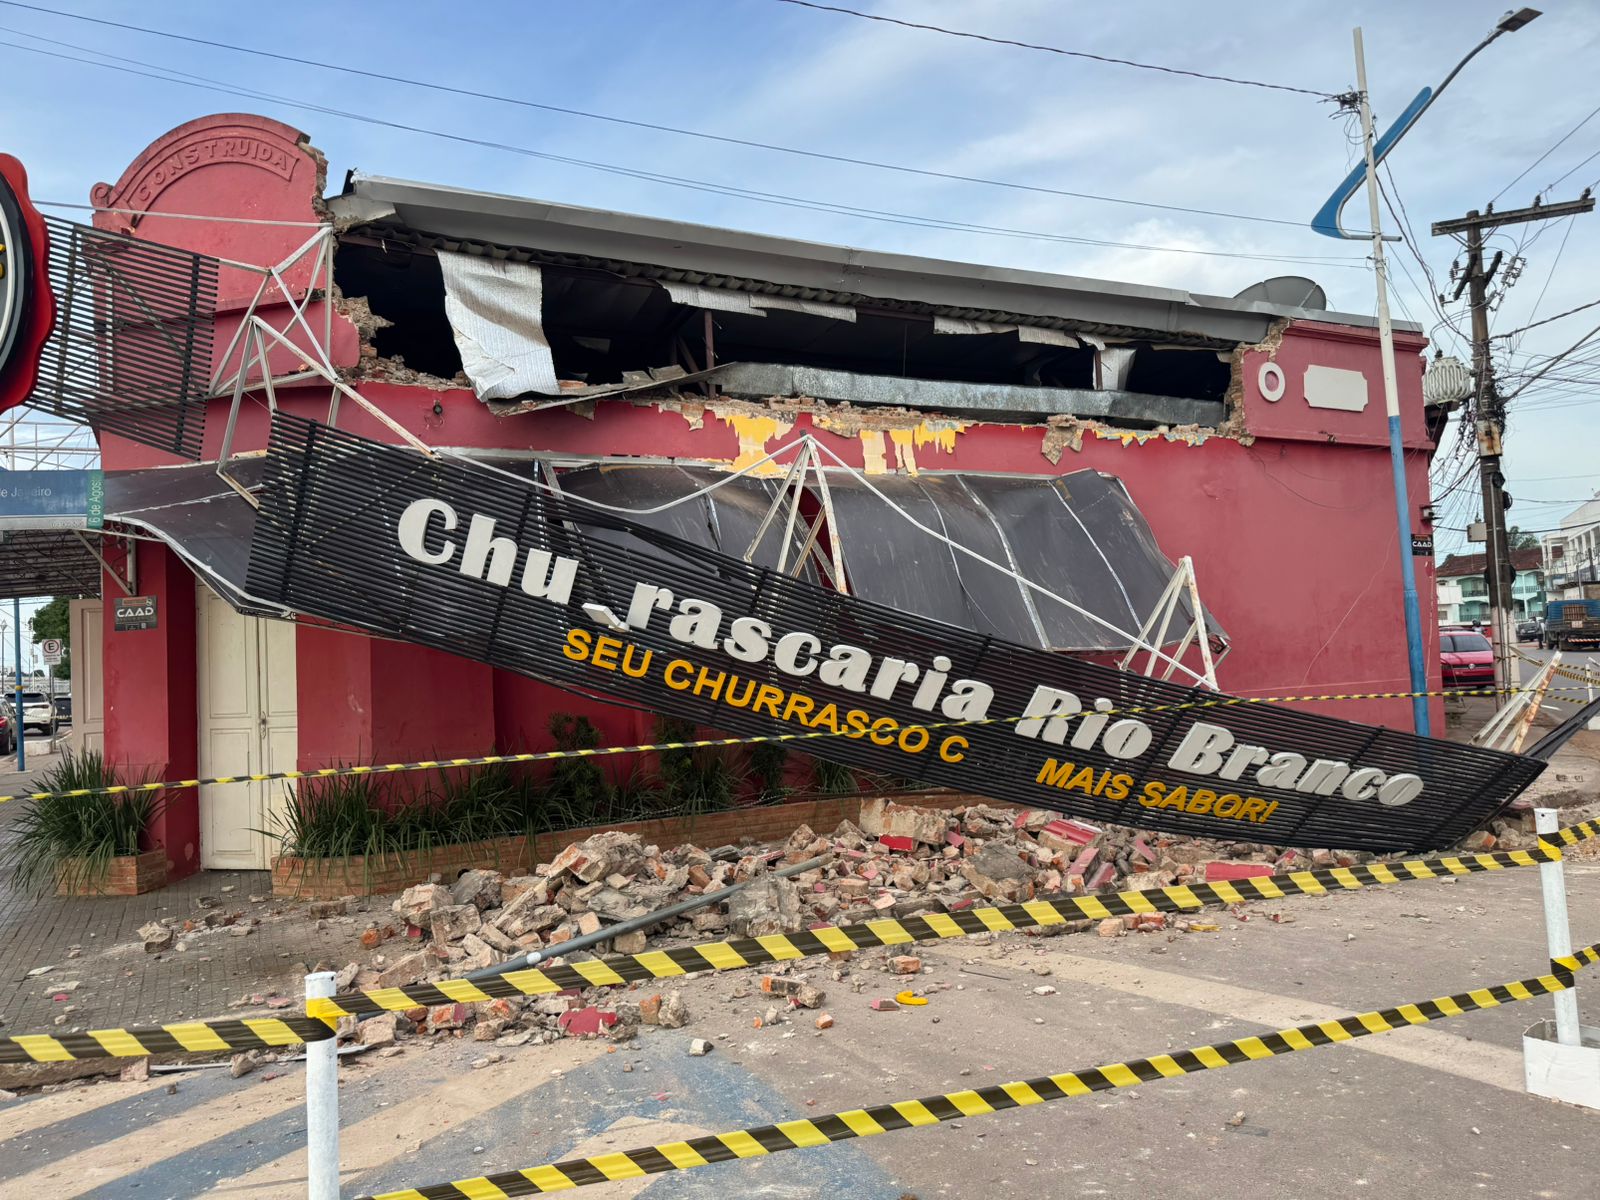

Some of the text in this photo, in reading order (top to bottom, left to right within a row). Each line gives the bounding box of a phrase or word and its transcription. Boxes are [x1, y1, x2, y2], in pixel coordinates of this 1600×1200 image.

[138, 139, 288, 202] CONSTRUIDA
[0, 486, 52, 497] e Jaeiro
[89, 504, 101, 516] de
[116, 607, 154, 618] CAAD
[49, 642, 55, 650] E
[562, 629, 653, 678] SEU
[664, 659, 930, 753] CHURRASCO
[1014, 684, 1153, 759] Rio
[1167, 721, 1424, 806] Branco
[1036, 758, 1279, 823] MAIS SABOR!
